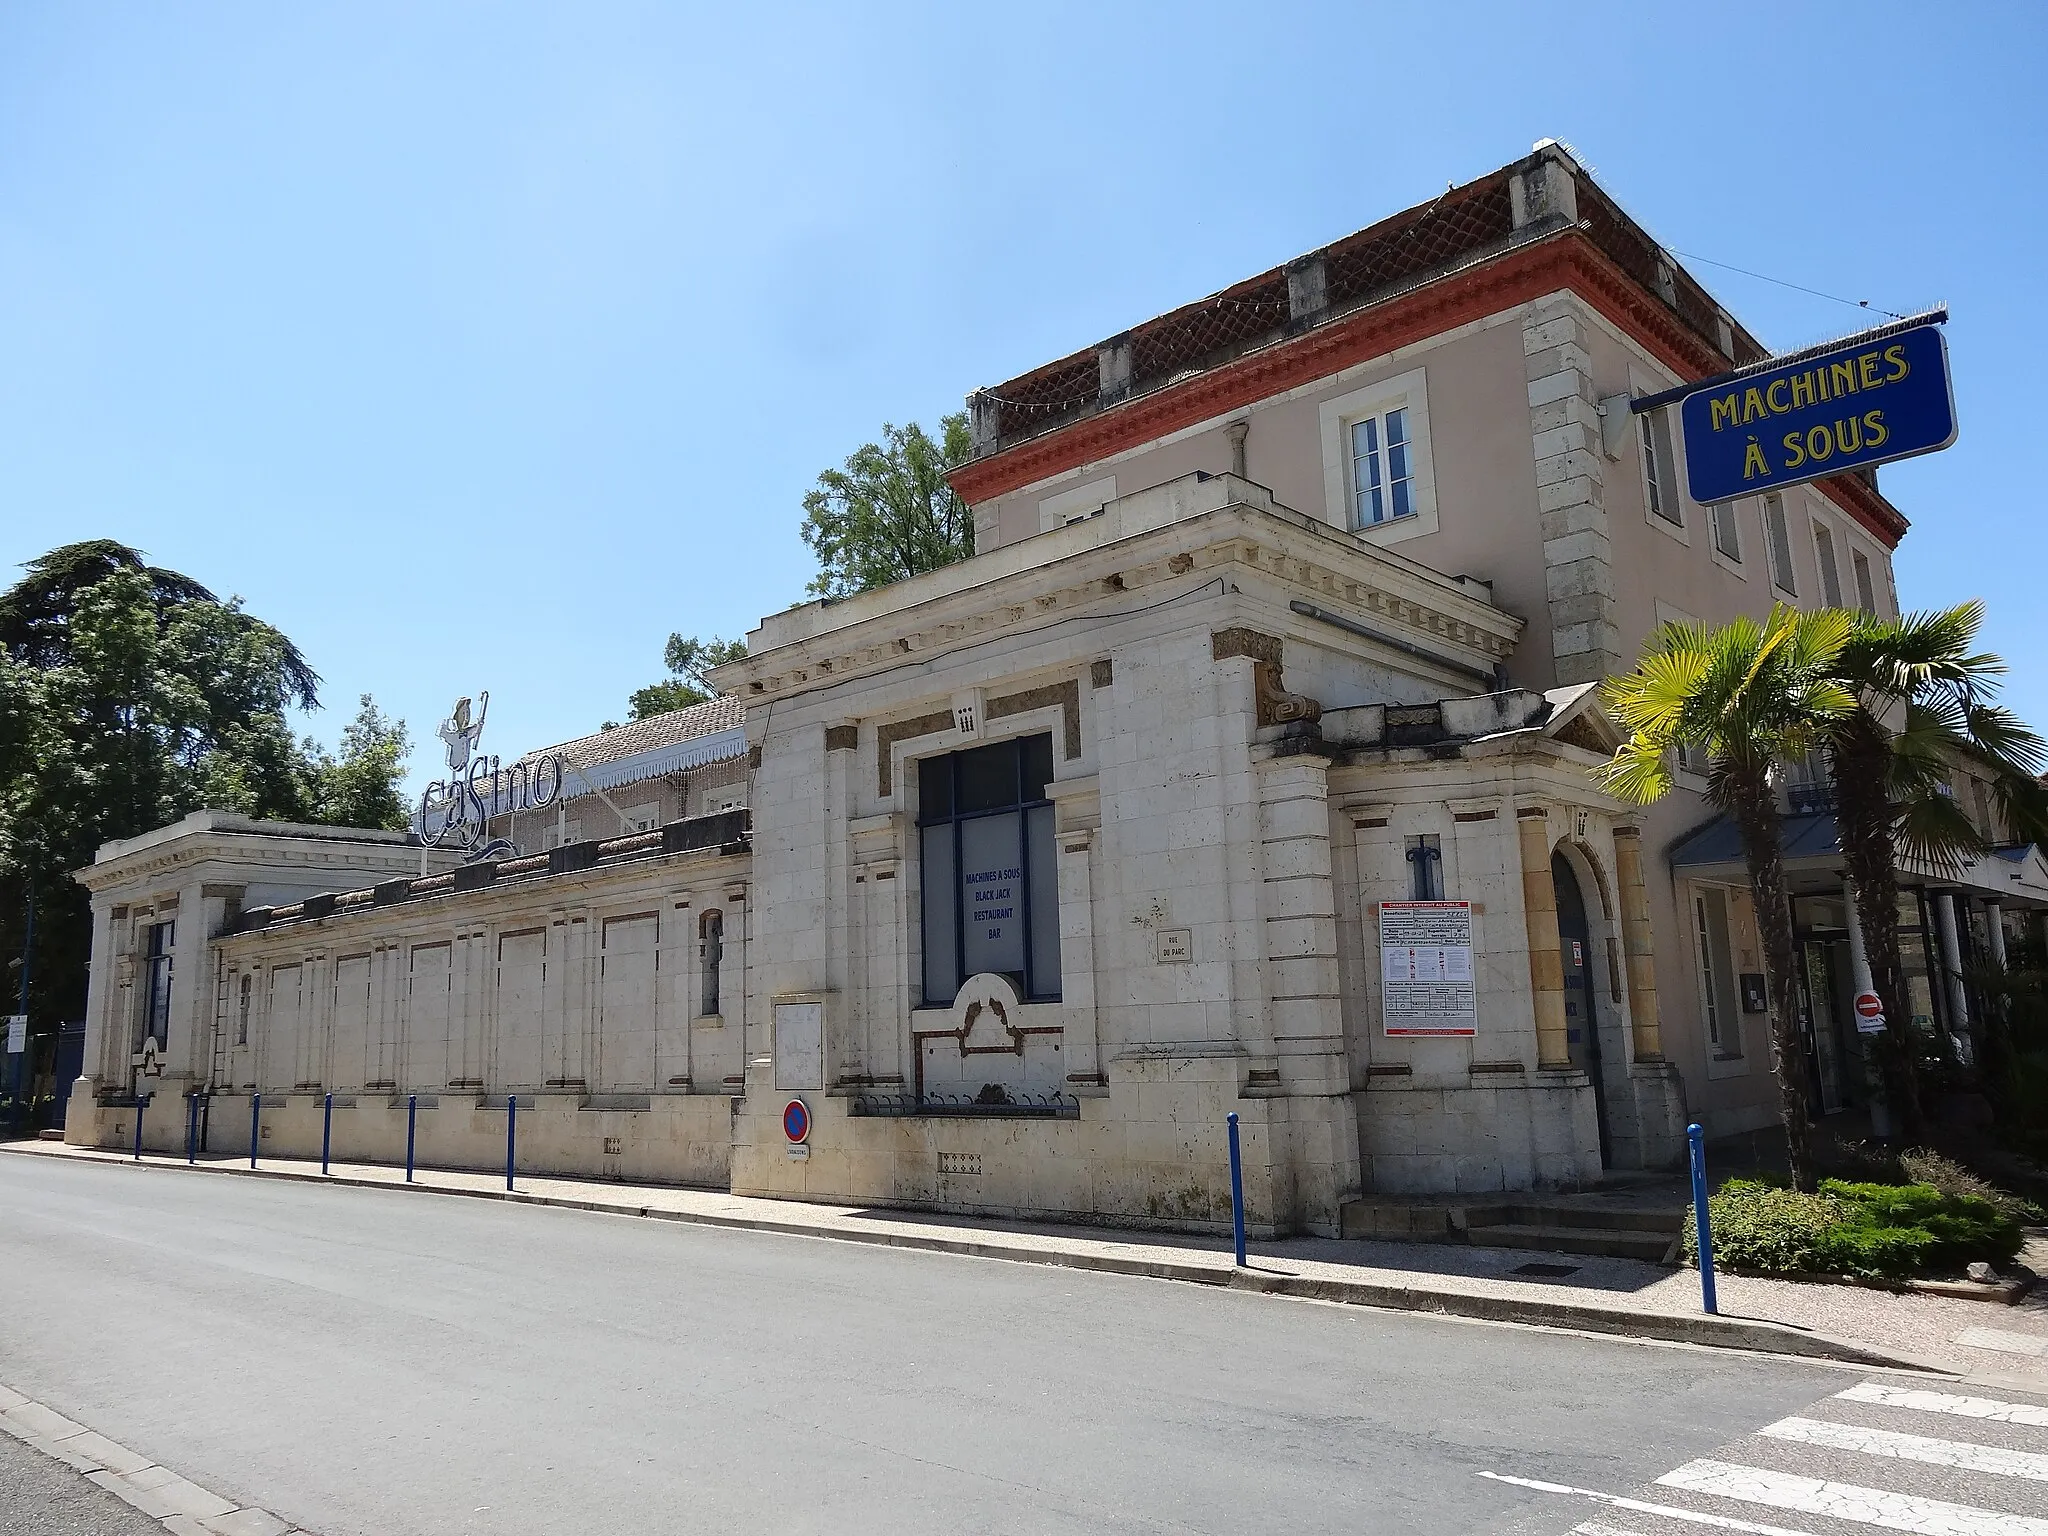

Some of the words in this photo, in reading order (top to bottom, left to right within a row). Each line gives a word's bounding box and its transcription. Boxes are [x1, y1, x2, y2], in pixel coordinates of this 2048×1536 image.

[1710, 345, 1911, 431] MACHINES
[1743, 435, 1771, 480] À
[1783, 410, 1889, 468] SOUS
[966, 871, 997, 884] MACHINES
[1003, 868, 1020, 879] SOUS
[976, 889, 994, 901] BLACK
[995, 888, 1011, 899] JACK
[974, 908, 1013, 921] RESTAURANT
[988, 928, 1001, 939] BAR
